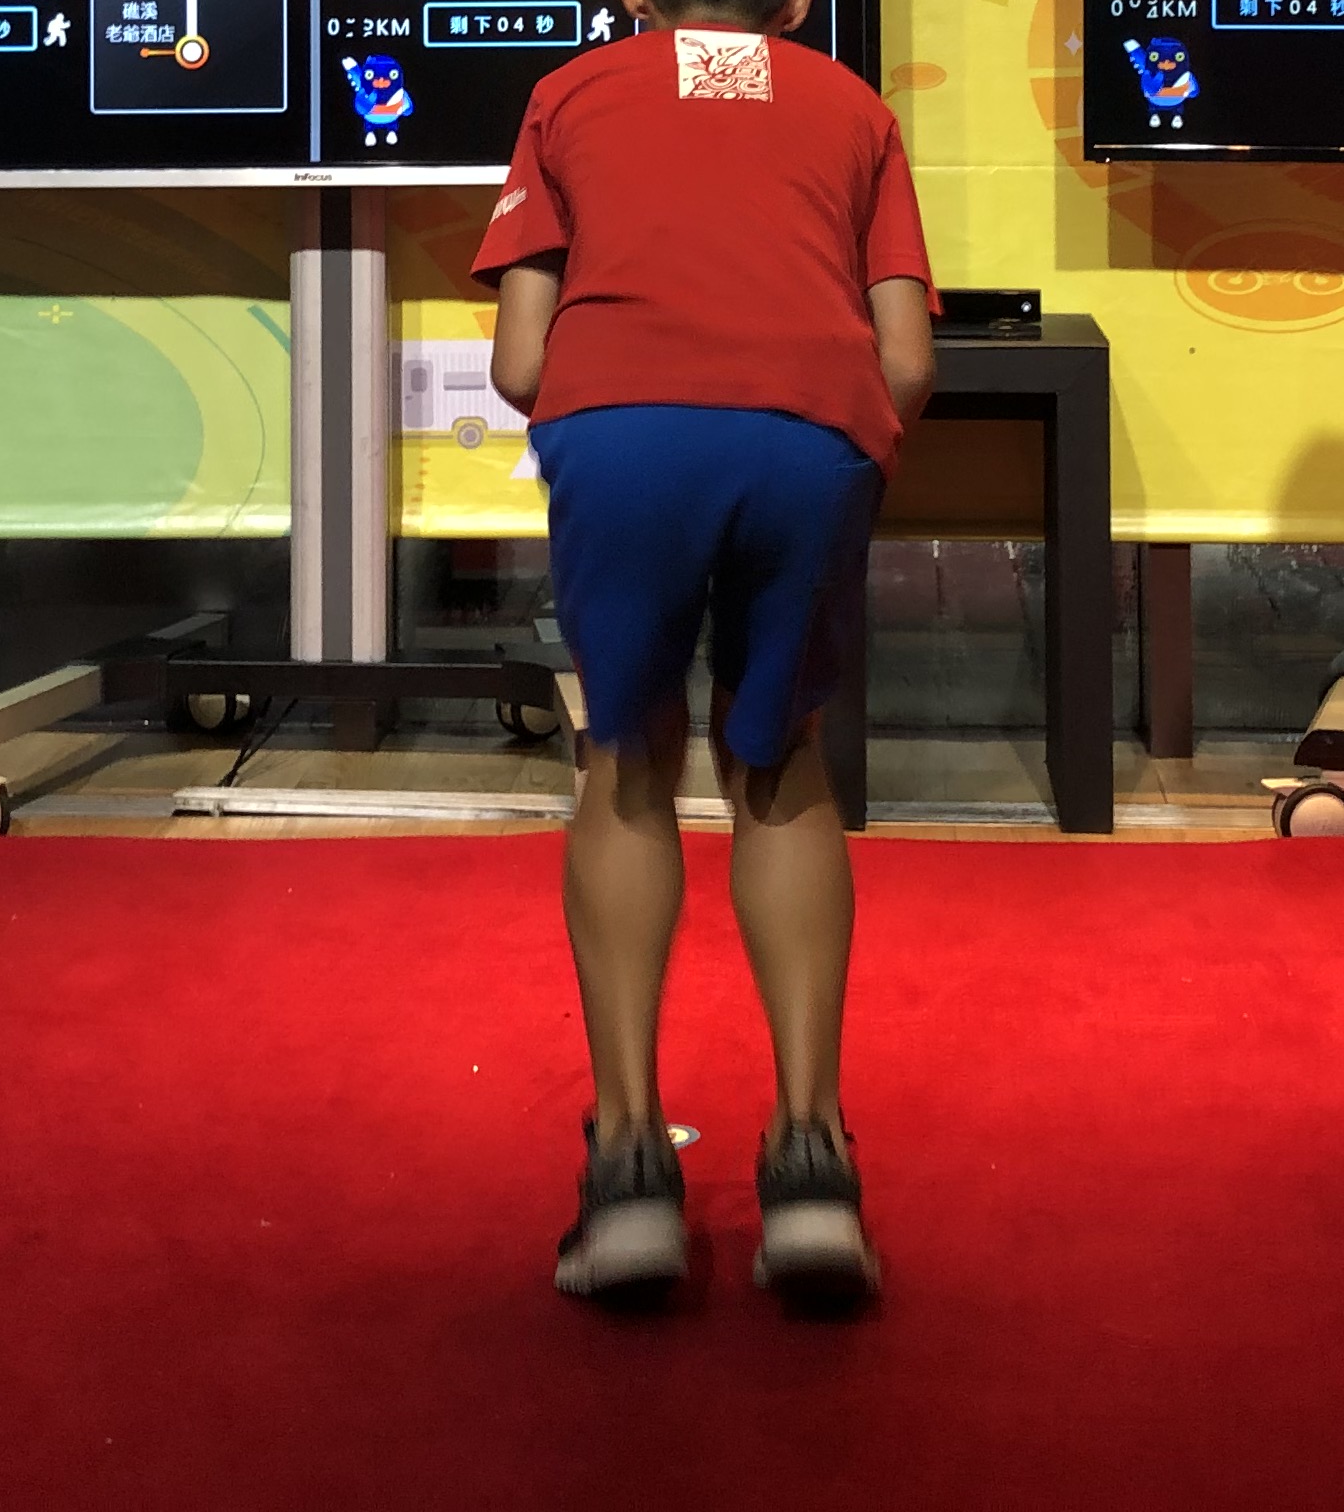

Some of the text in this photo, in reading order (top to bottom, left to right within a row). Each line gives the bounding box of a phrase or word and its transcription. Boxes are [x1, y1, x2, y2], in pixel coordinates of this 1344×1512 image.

[105, 23, 176, 44] 老爺酒店
[293, 172, 333, 182] InFocus
